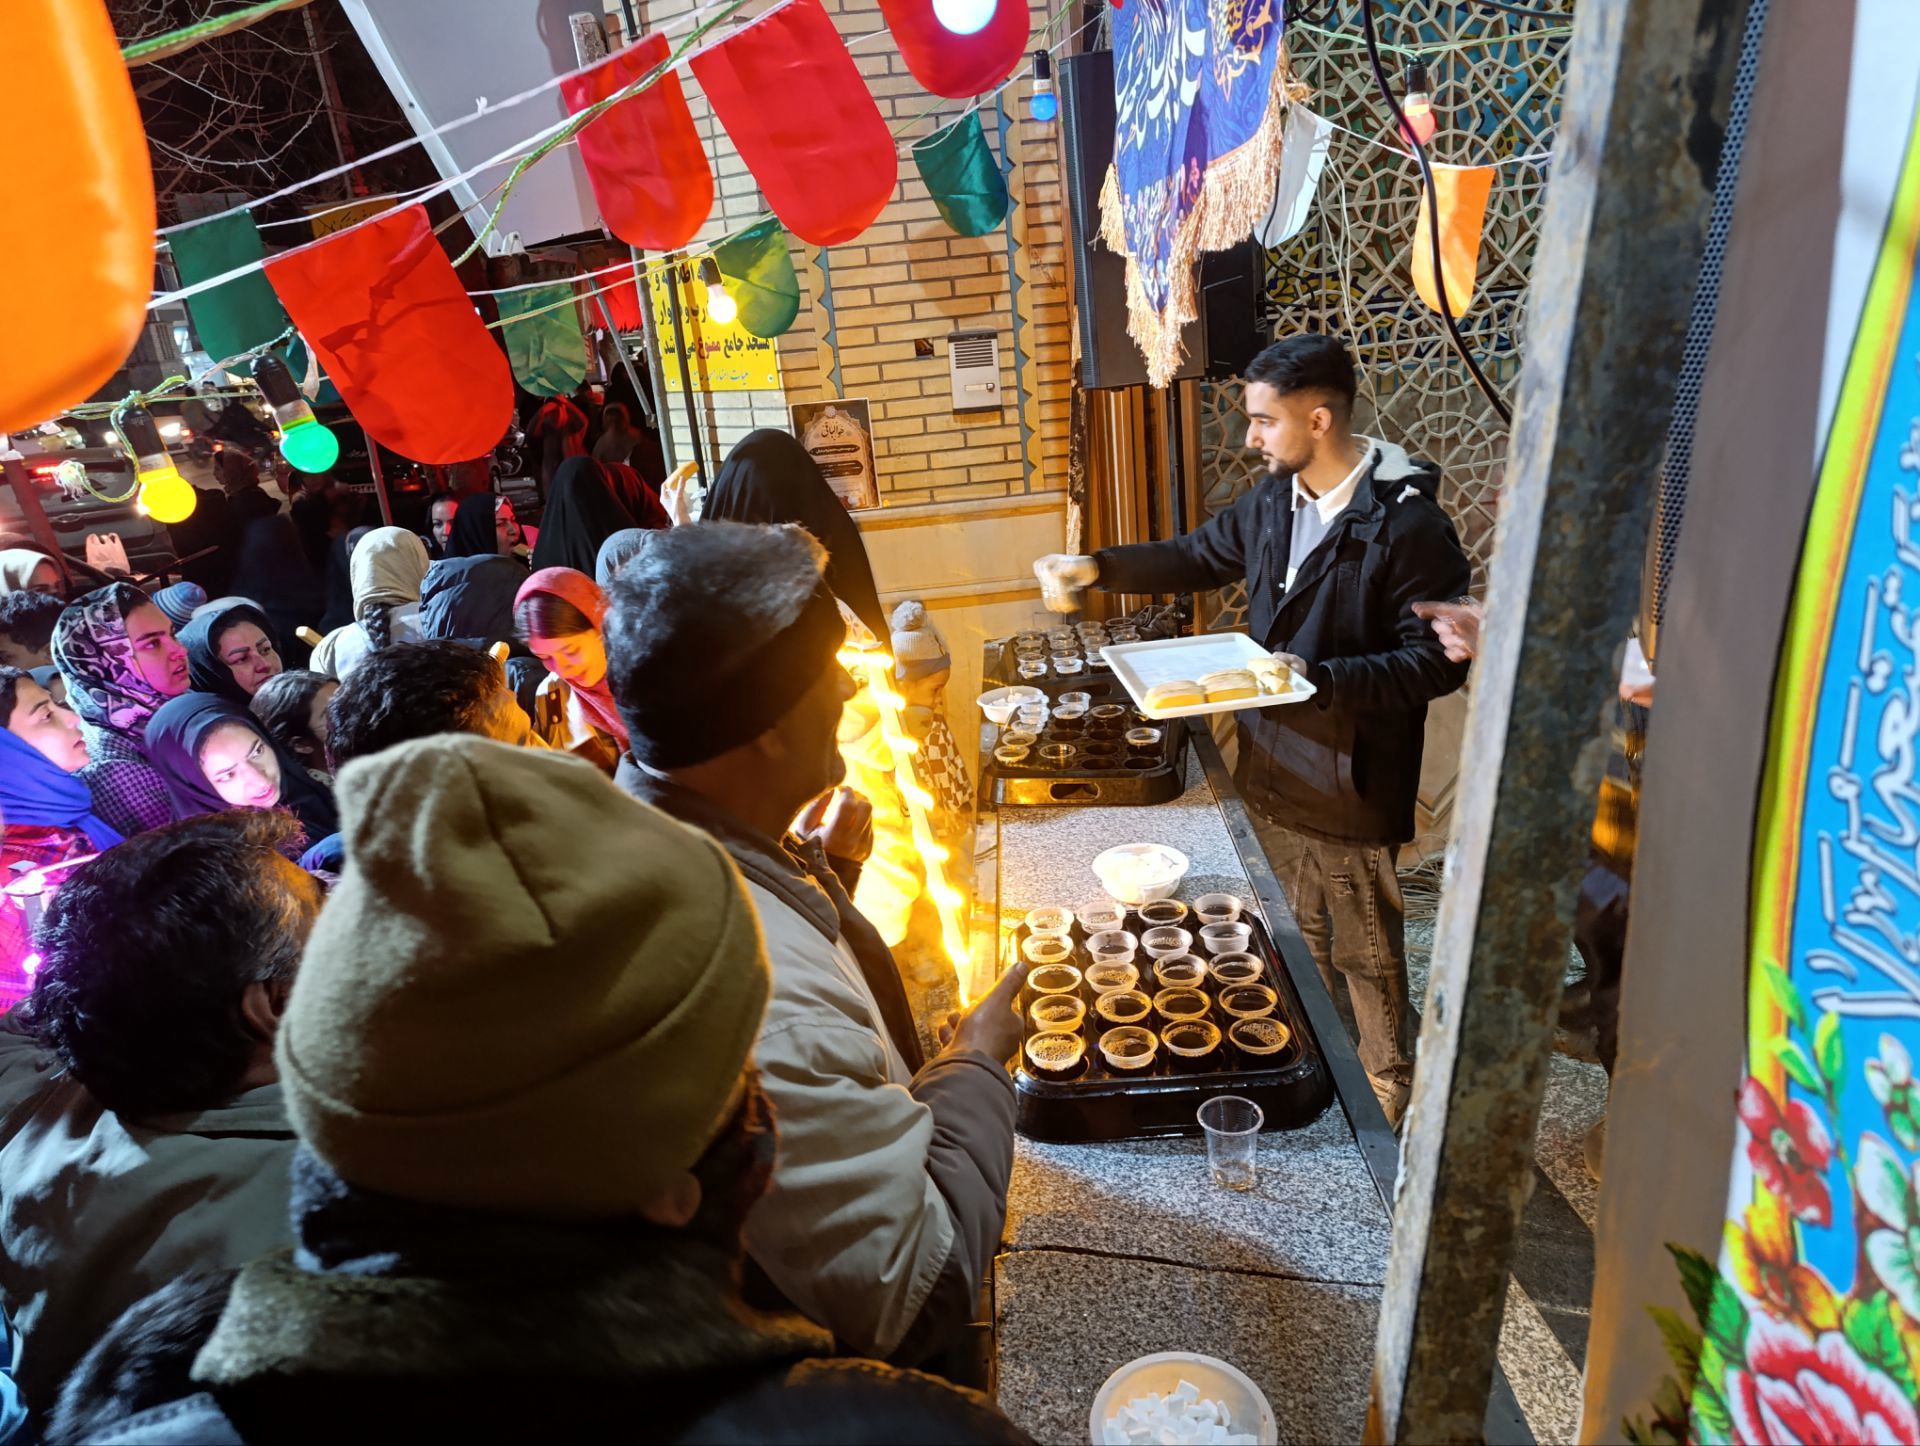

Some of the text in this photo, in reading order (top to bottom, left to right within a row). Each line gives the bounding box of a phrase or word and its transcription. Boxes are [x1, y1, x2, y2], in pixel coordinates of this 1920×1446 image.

[698, 336, 721, 360] ممنوع
[723, 331, 744, 359] جامع
[745, 336, 771, 357] مسجد
